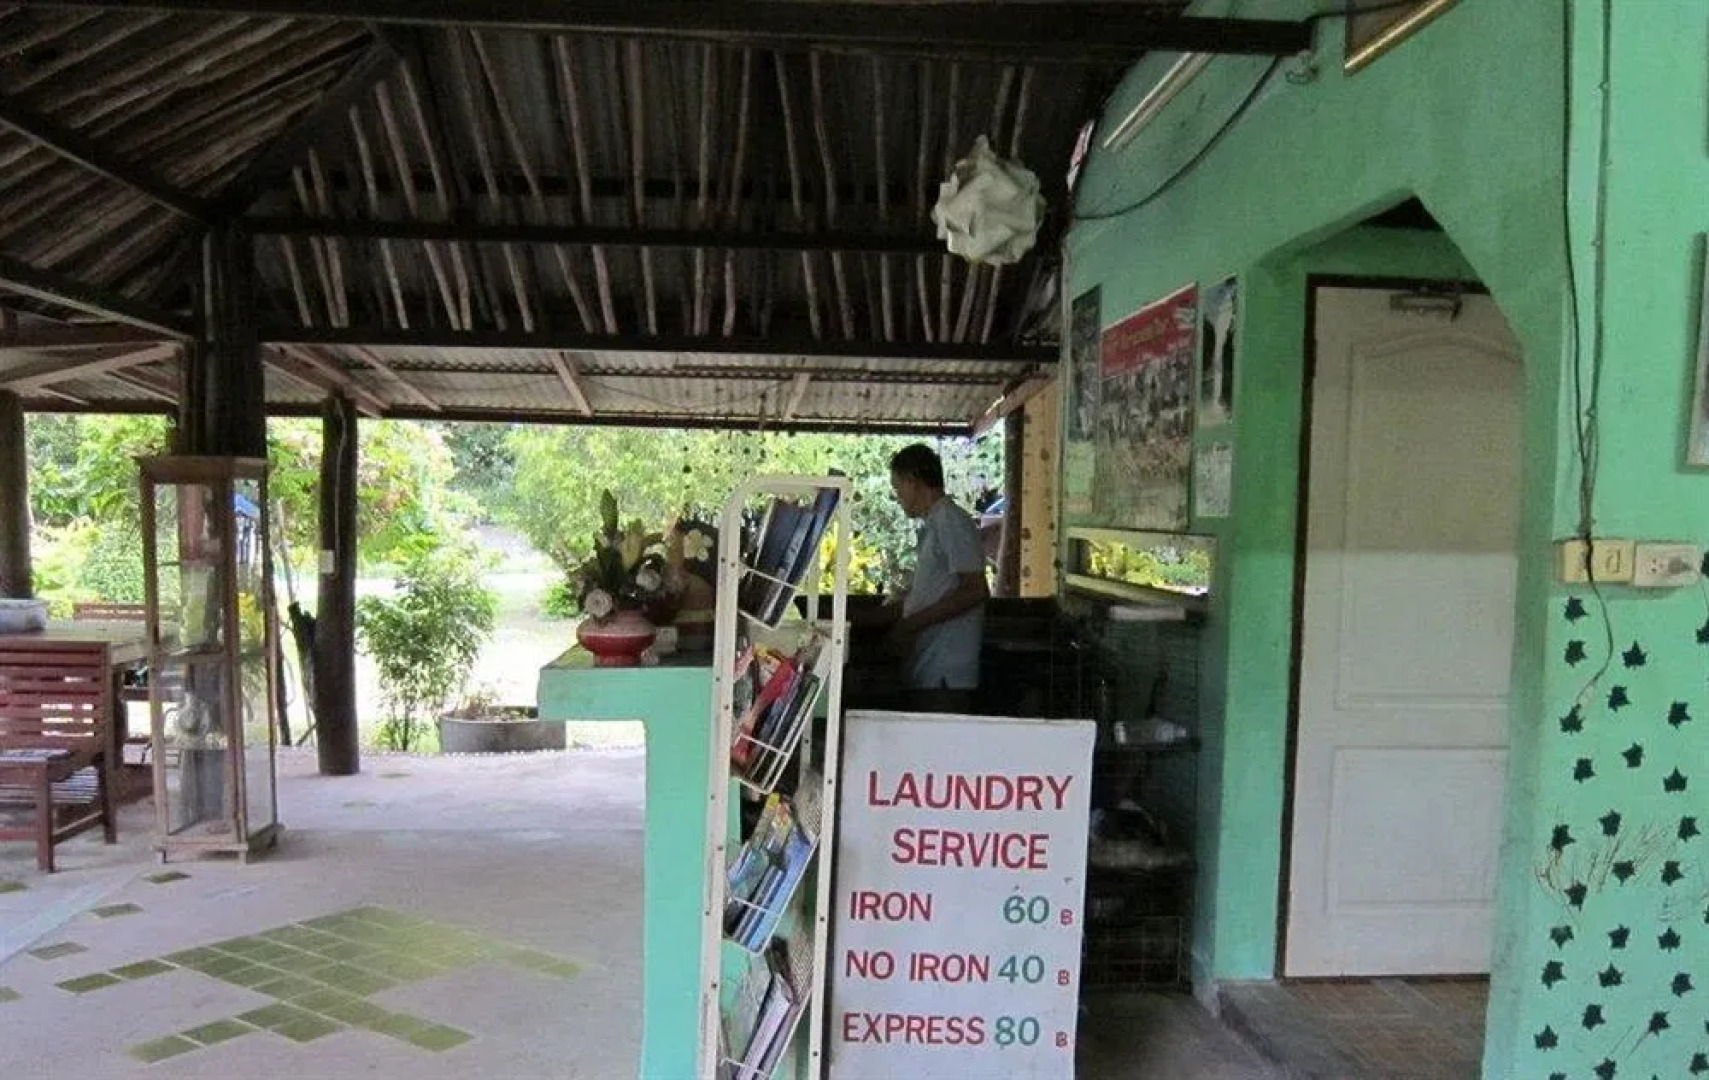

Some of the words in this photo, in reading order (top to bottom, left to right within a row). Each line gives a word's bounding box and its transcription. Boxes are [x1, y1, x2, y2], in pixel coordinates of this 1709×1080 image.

[868, 770, 1073, 811] LAUNDRY
[891, 828, 1050, 870] SERVICE
[849, 891, 932, 922] IRON
[1003, 895, 1051, 924] 60
[1060, 908, 1073, 926] B
[845, 949, 895, 980] NO
[909, 953, 990, 983] IRON
[998, 955, 1046, 984] 40
[1057, 969, 1071, 986] B
[843, 1012, 986, 1046] EXPRESS
[994, 1016, 1040, 1047] 80
